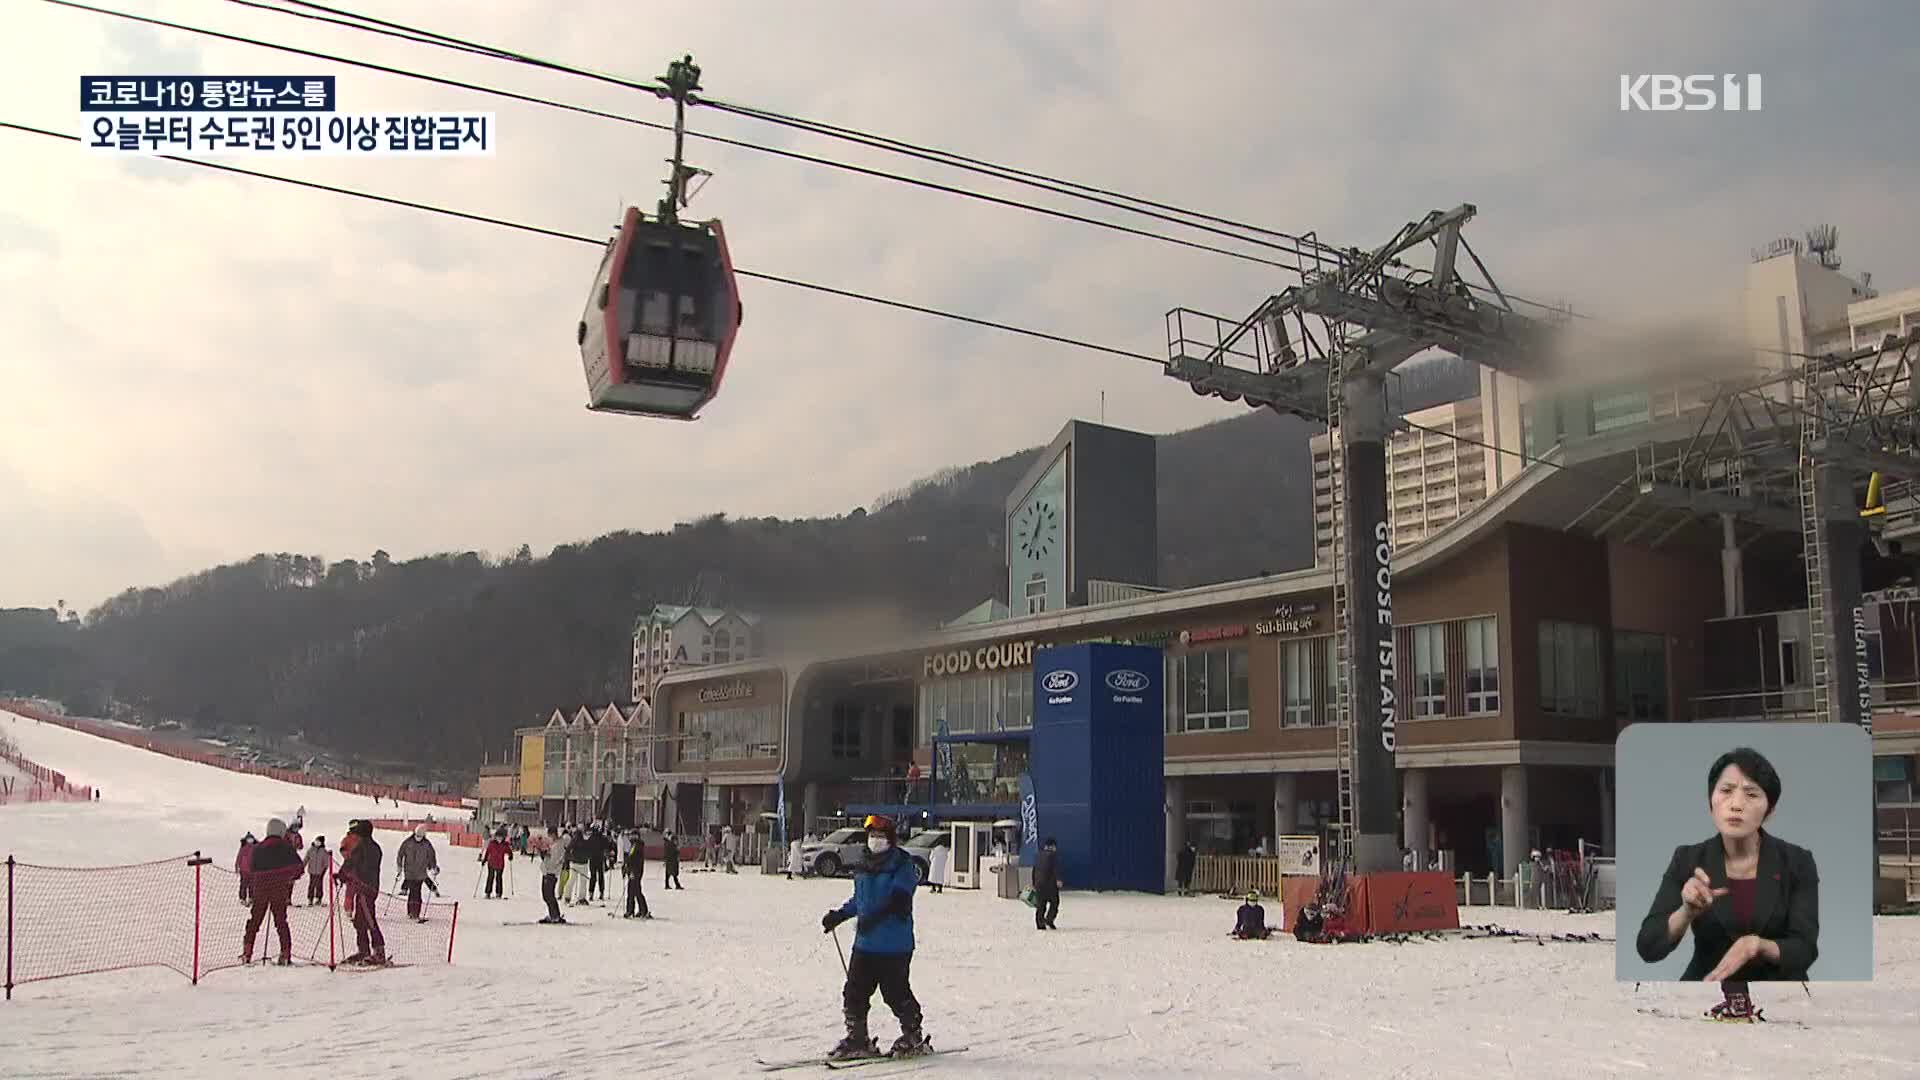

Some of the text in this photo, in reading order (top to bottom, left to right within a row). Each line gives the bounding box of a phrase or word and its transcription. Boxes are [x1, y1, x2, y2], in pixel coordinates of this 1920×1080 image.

[1374, 521, 1397, 752] GOOSE ISLAND
[1852, 607, 1867, 657] GREAT
[923, 640, 1034, 677] FOOD COURT
[1856, 662, 1869, 689] IPA
[1859, 693, 1872, 709] IS
